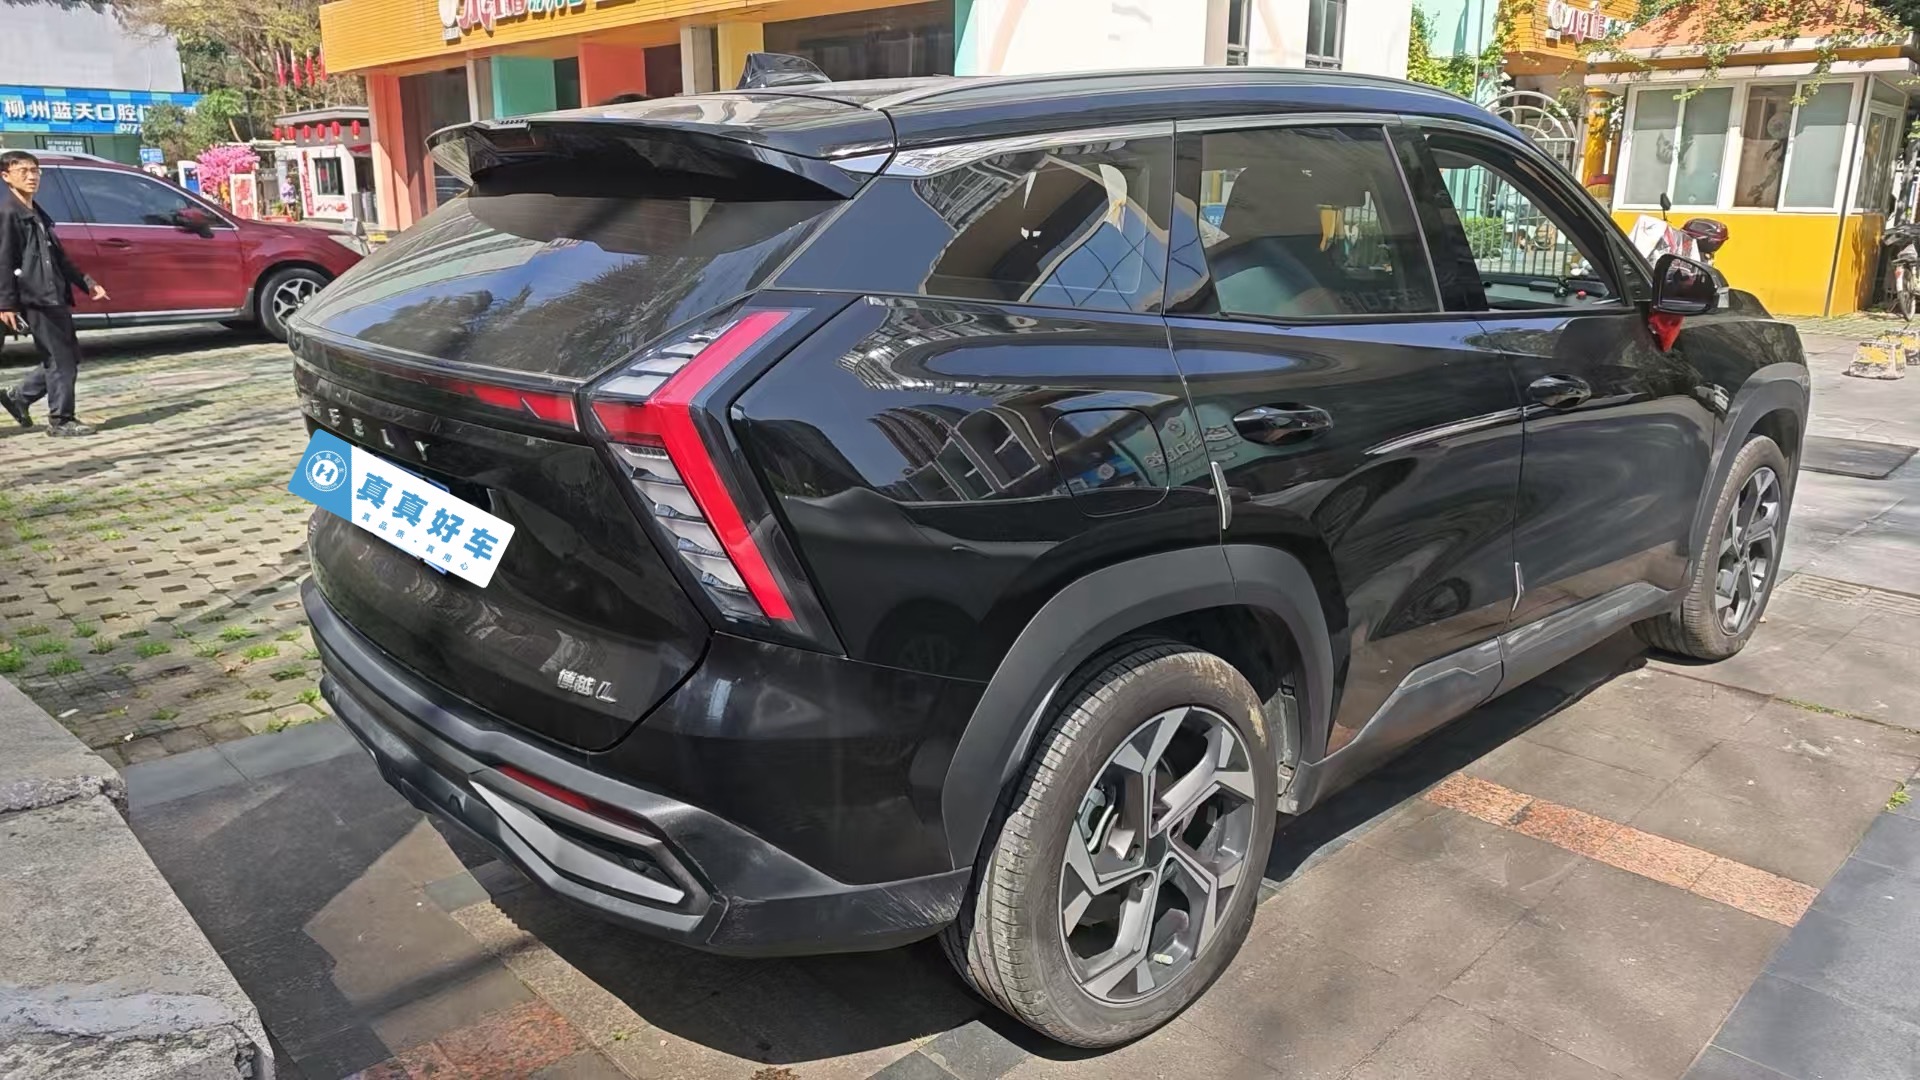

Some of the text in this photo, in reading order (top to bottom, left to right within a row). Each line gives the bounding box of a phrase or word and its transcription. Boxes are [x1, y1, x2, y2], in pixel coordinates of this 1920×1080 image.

[4, 99, 196, 122] 柳州蓝天口腔门
